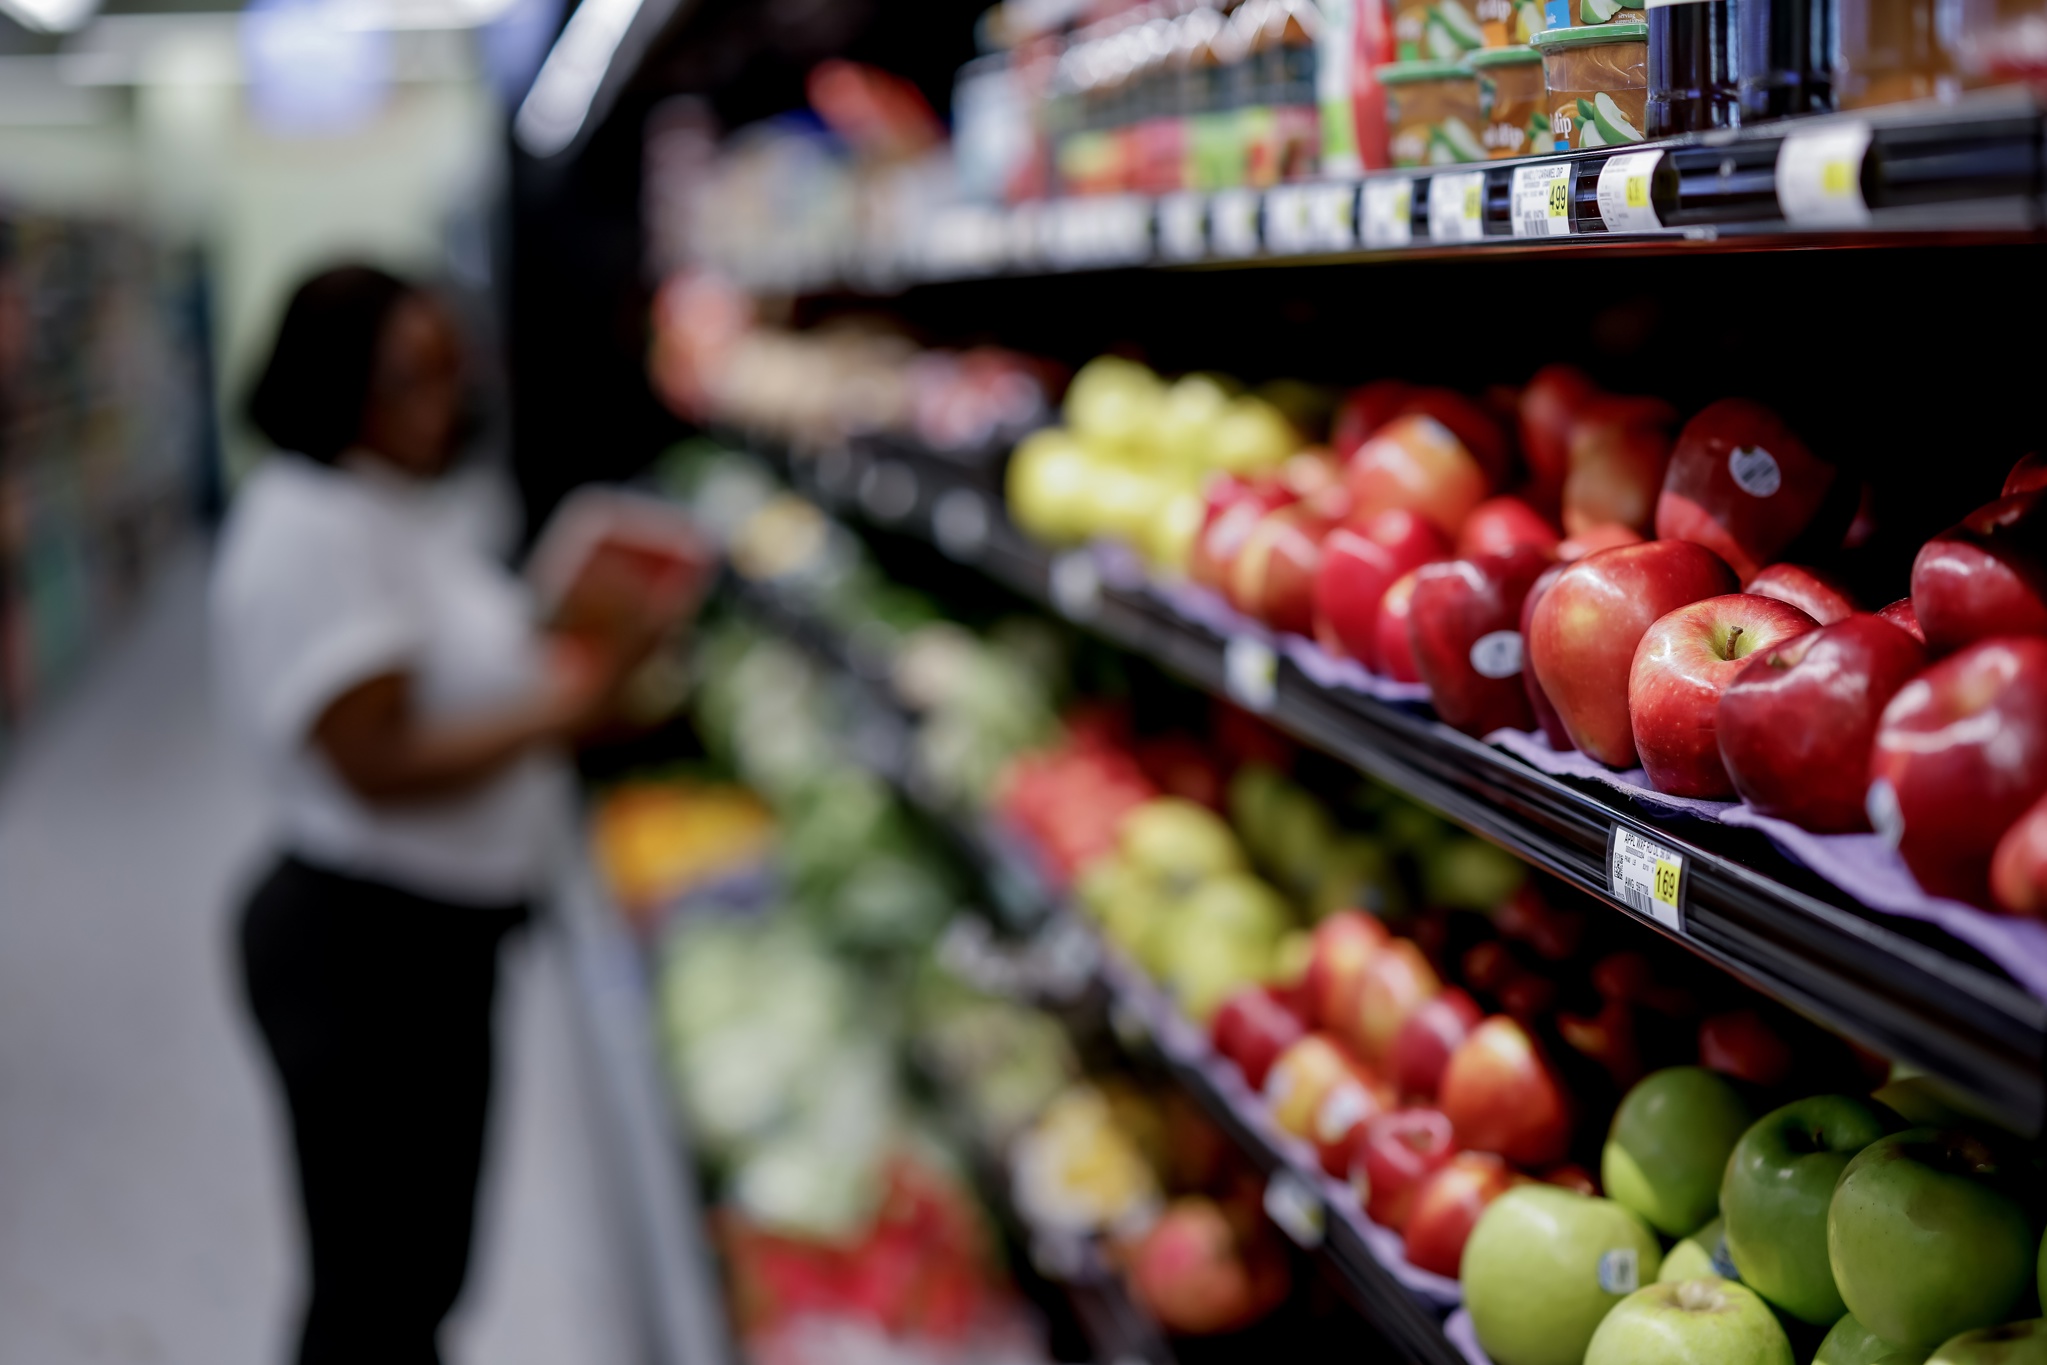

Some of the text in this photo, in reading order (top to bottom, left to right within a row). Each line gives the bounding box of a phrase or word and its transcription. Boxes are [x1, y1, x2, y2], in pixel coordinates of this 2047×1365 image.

[1554, 112, 1572, 139] dip
[1550, 184, 1566, 210] 499
[1657, 867, 1675, 898] 169
